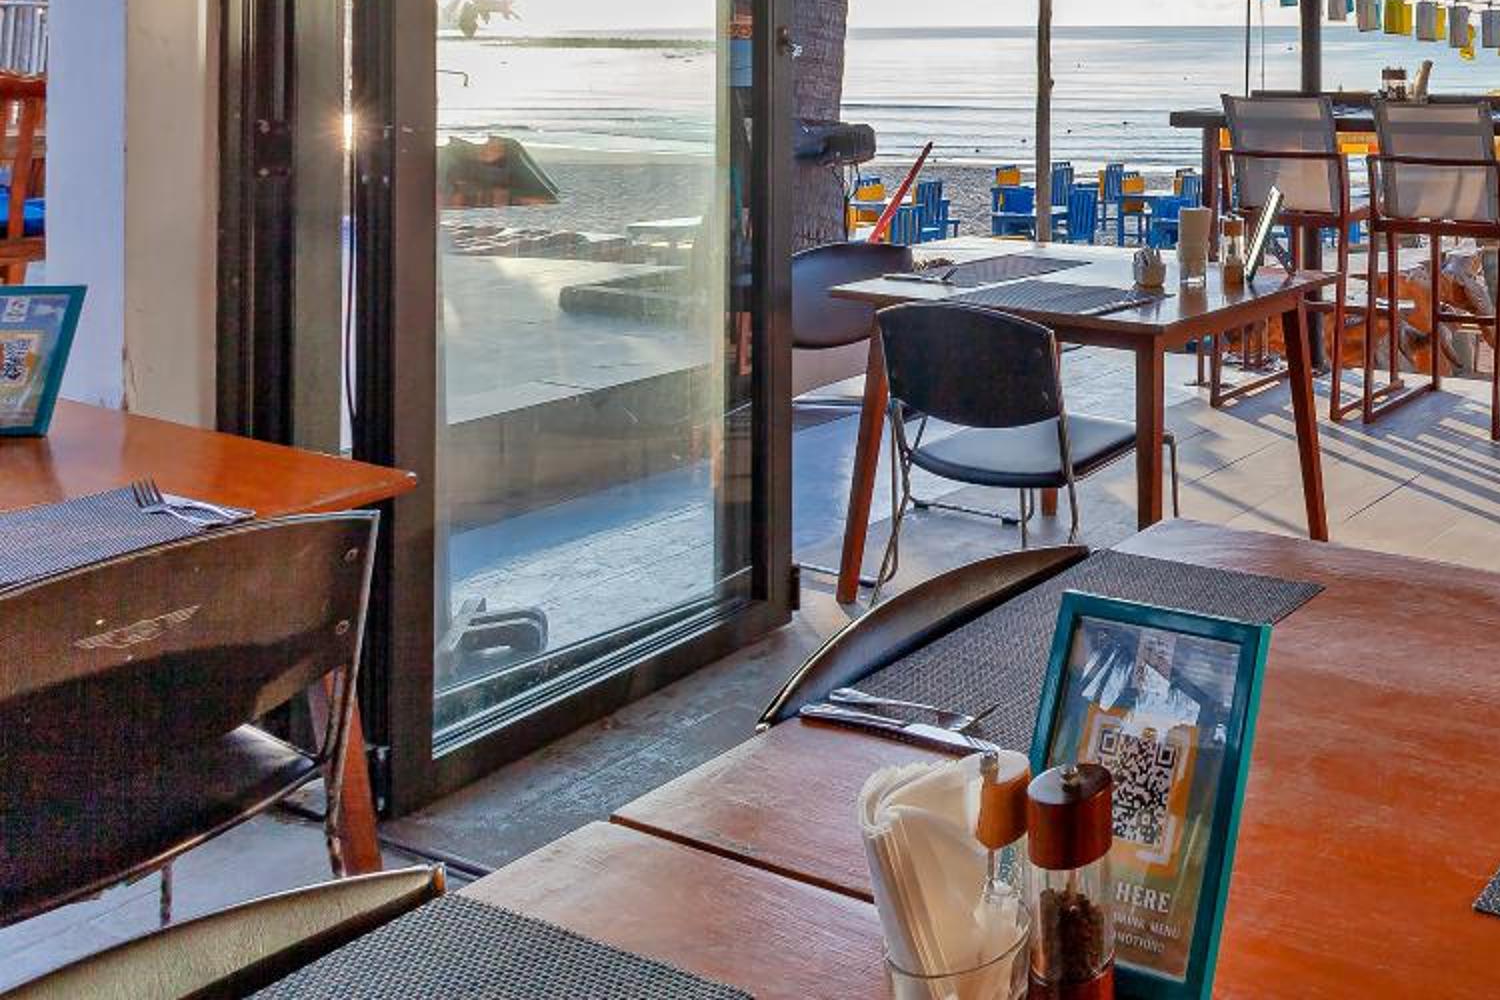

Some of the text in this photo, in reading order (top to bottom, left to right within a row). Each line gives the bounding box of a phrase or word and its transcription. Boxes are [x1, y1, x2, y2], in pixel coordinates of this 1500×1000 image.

[1116, 881, 1170, 913] HERE
[1112, 930, 1165, 953] MOTIONS
[1151, 921, 1180, 939] MENU
